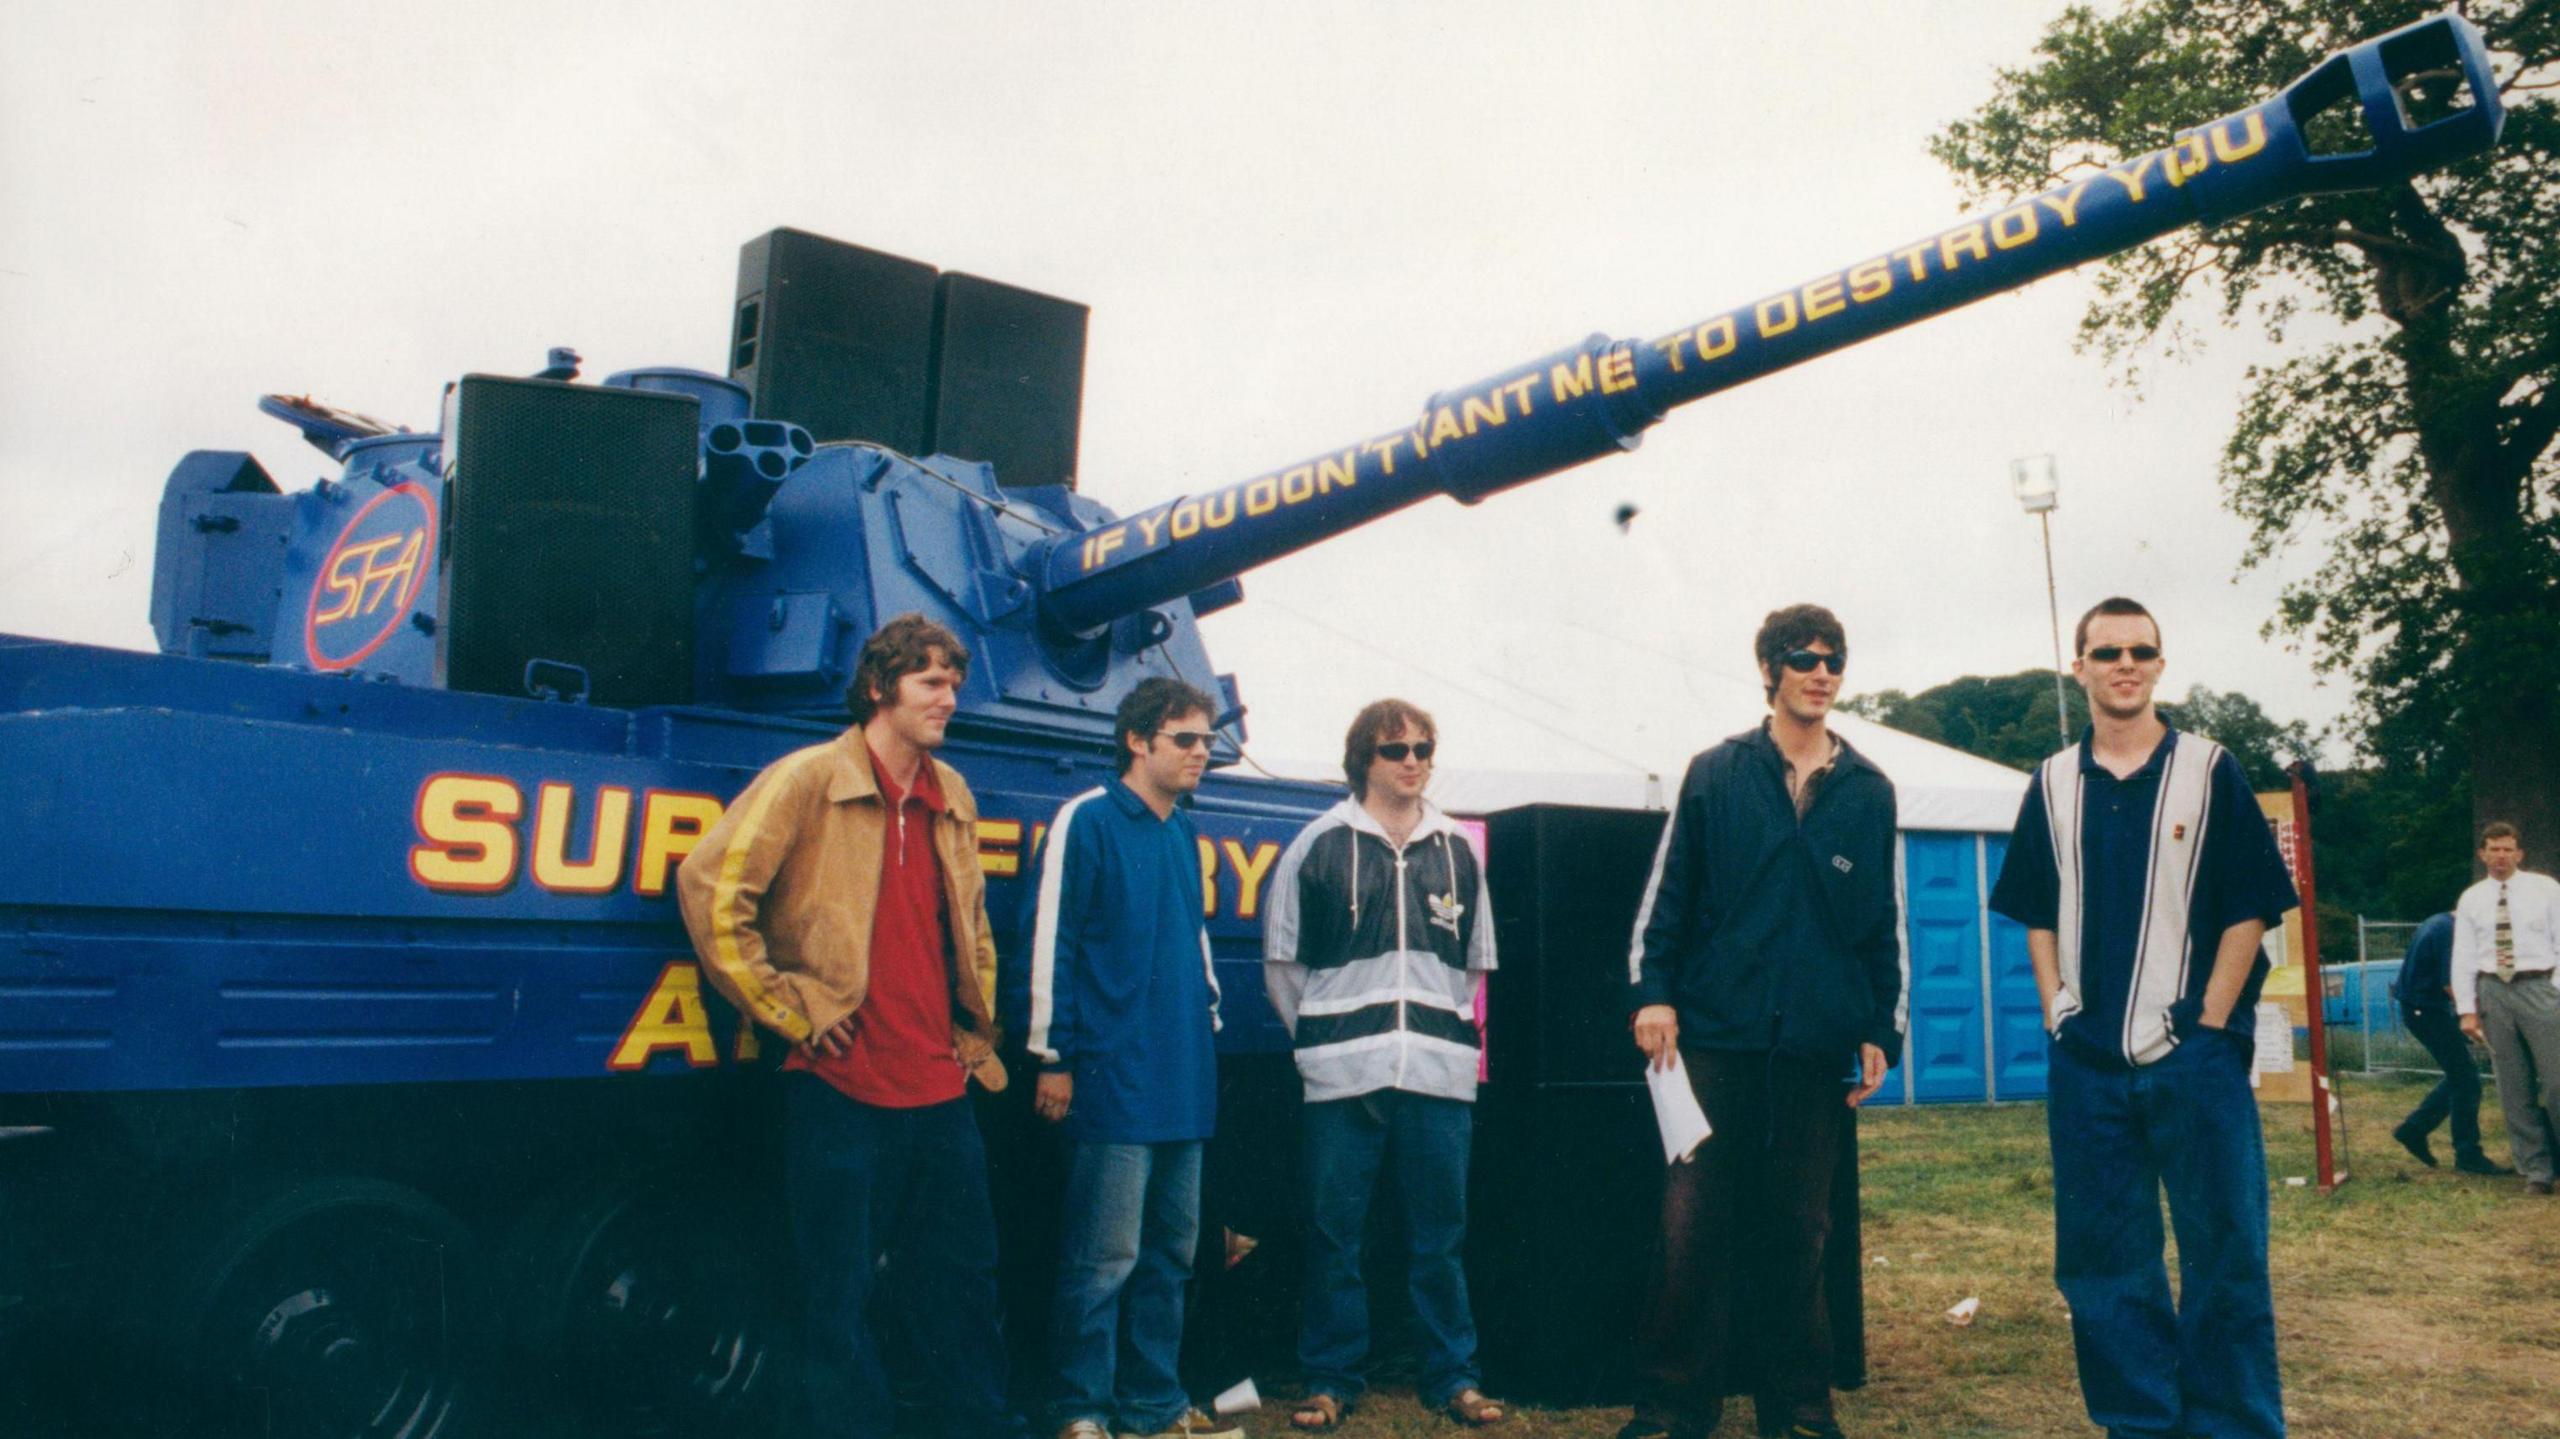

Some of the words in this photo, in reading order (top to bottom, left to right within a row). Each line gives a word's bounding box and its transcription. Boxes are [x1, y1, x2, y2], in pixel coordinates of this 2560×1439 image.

[1081, 525, 1127, 570] IF
[1138, 490, 1237, 547] YOU
[1243, 432, 1404, 517] DON'T
[1550, 347, 1638, 404] ME
[1656, 314, 1737, 374] TO
[1755, 182, 2087, 340] DESTROY
[2107, 111, 2268, 204] YOU
[315, 527, 425, 625] SFA
[408, 771, 726, 896] SUP
